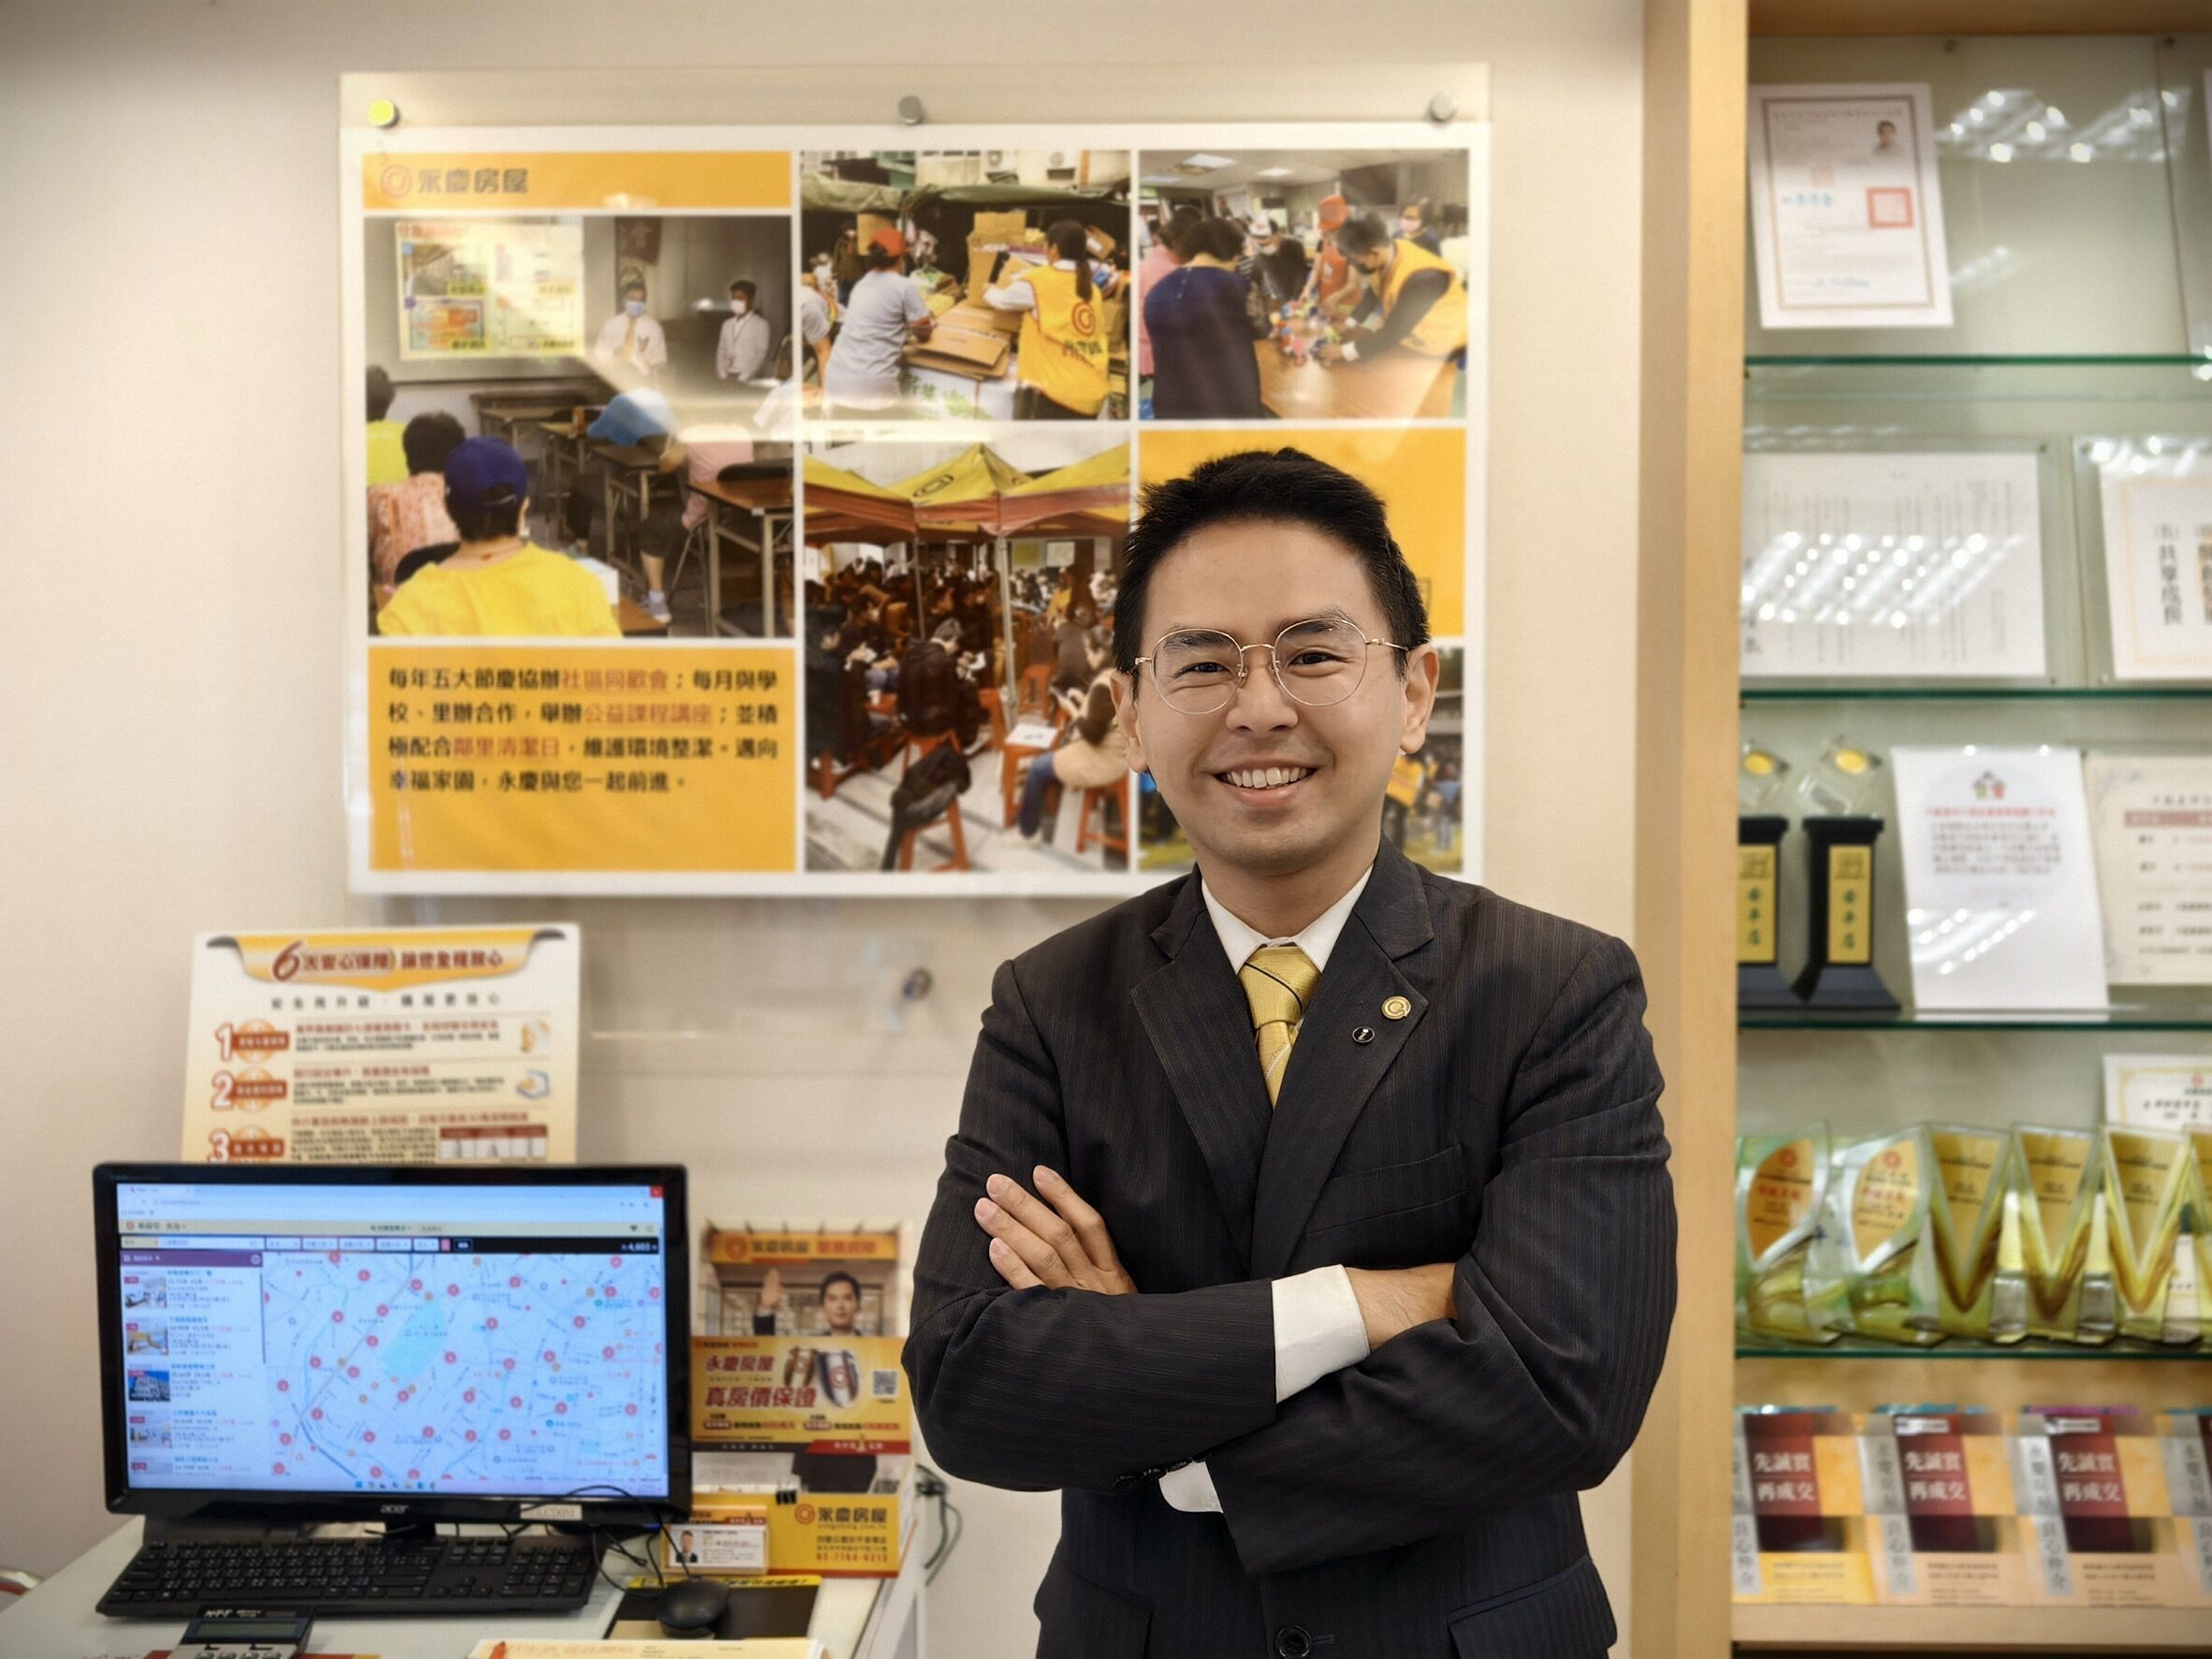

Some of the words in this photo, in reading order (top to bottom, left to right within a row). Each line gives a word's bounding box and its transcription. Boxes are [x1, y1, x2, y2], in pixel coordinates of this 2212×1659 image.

[705, 1386, 817, 1408] 真房價保證
[380, 1503, 408, 1514] acer
